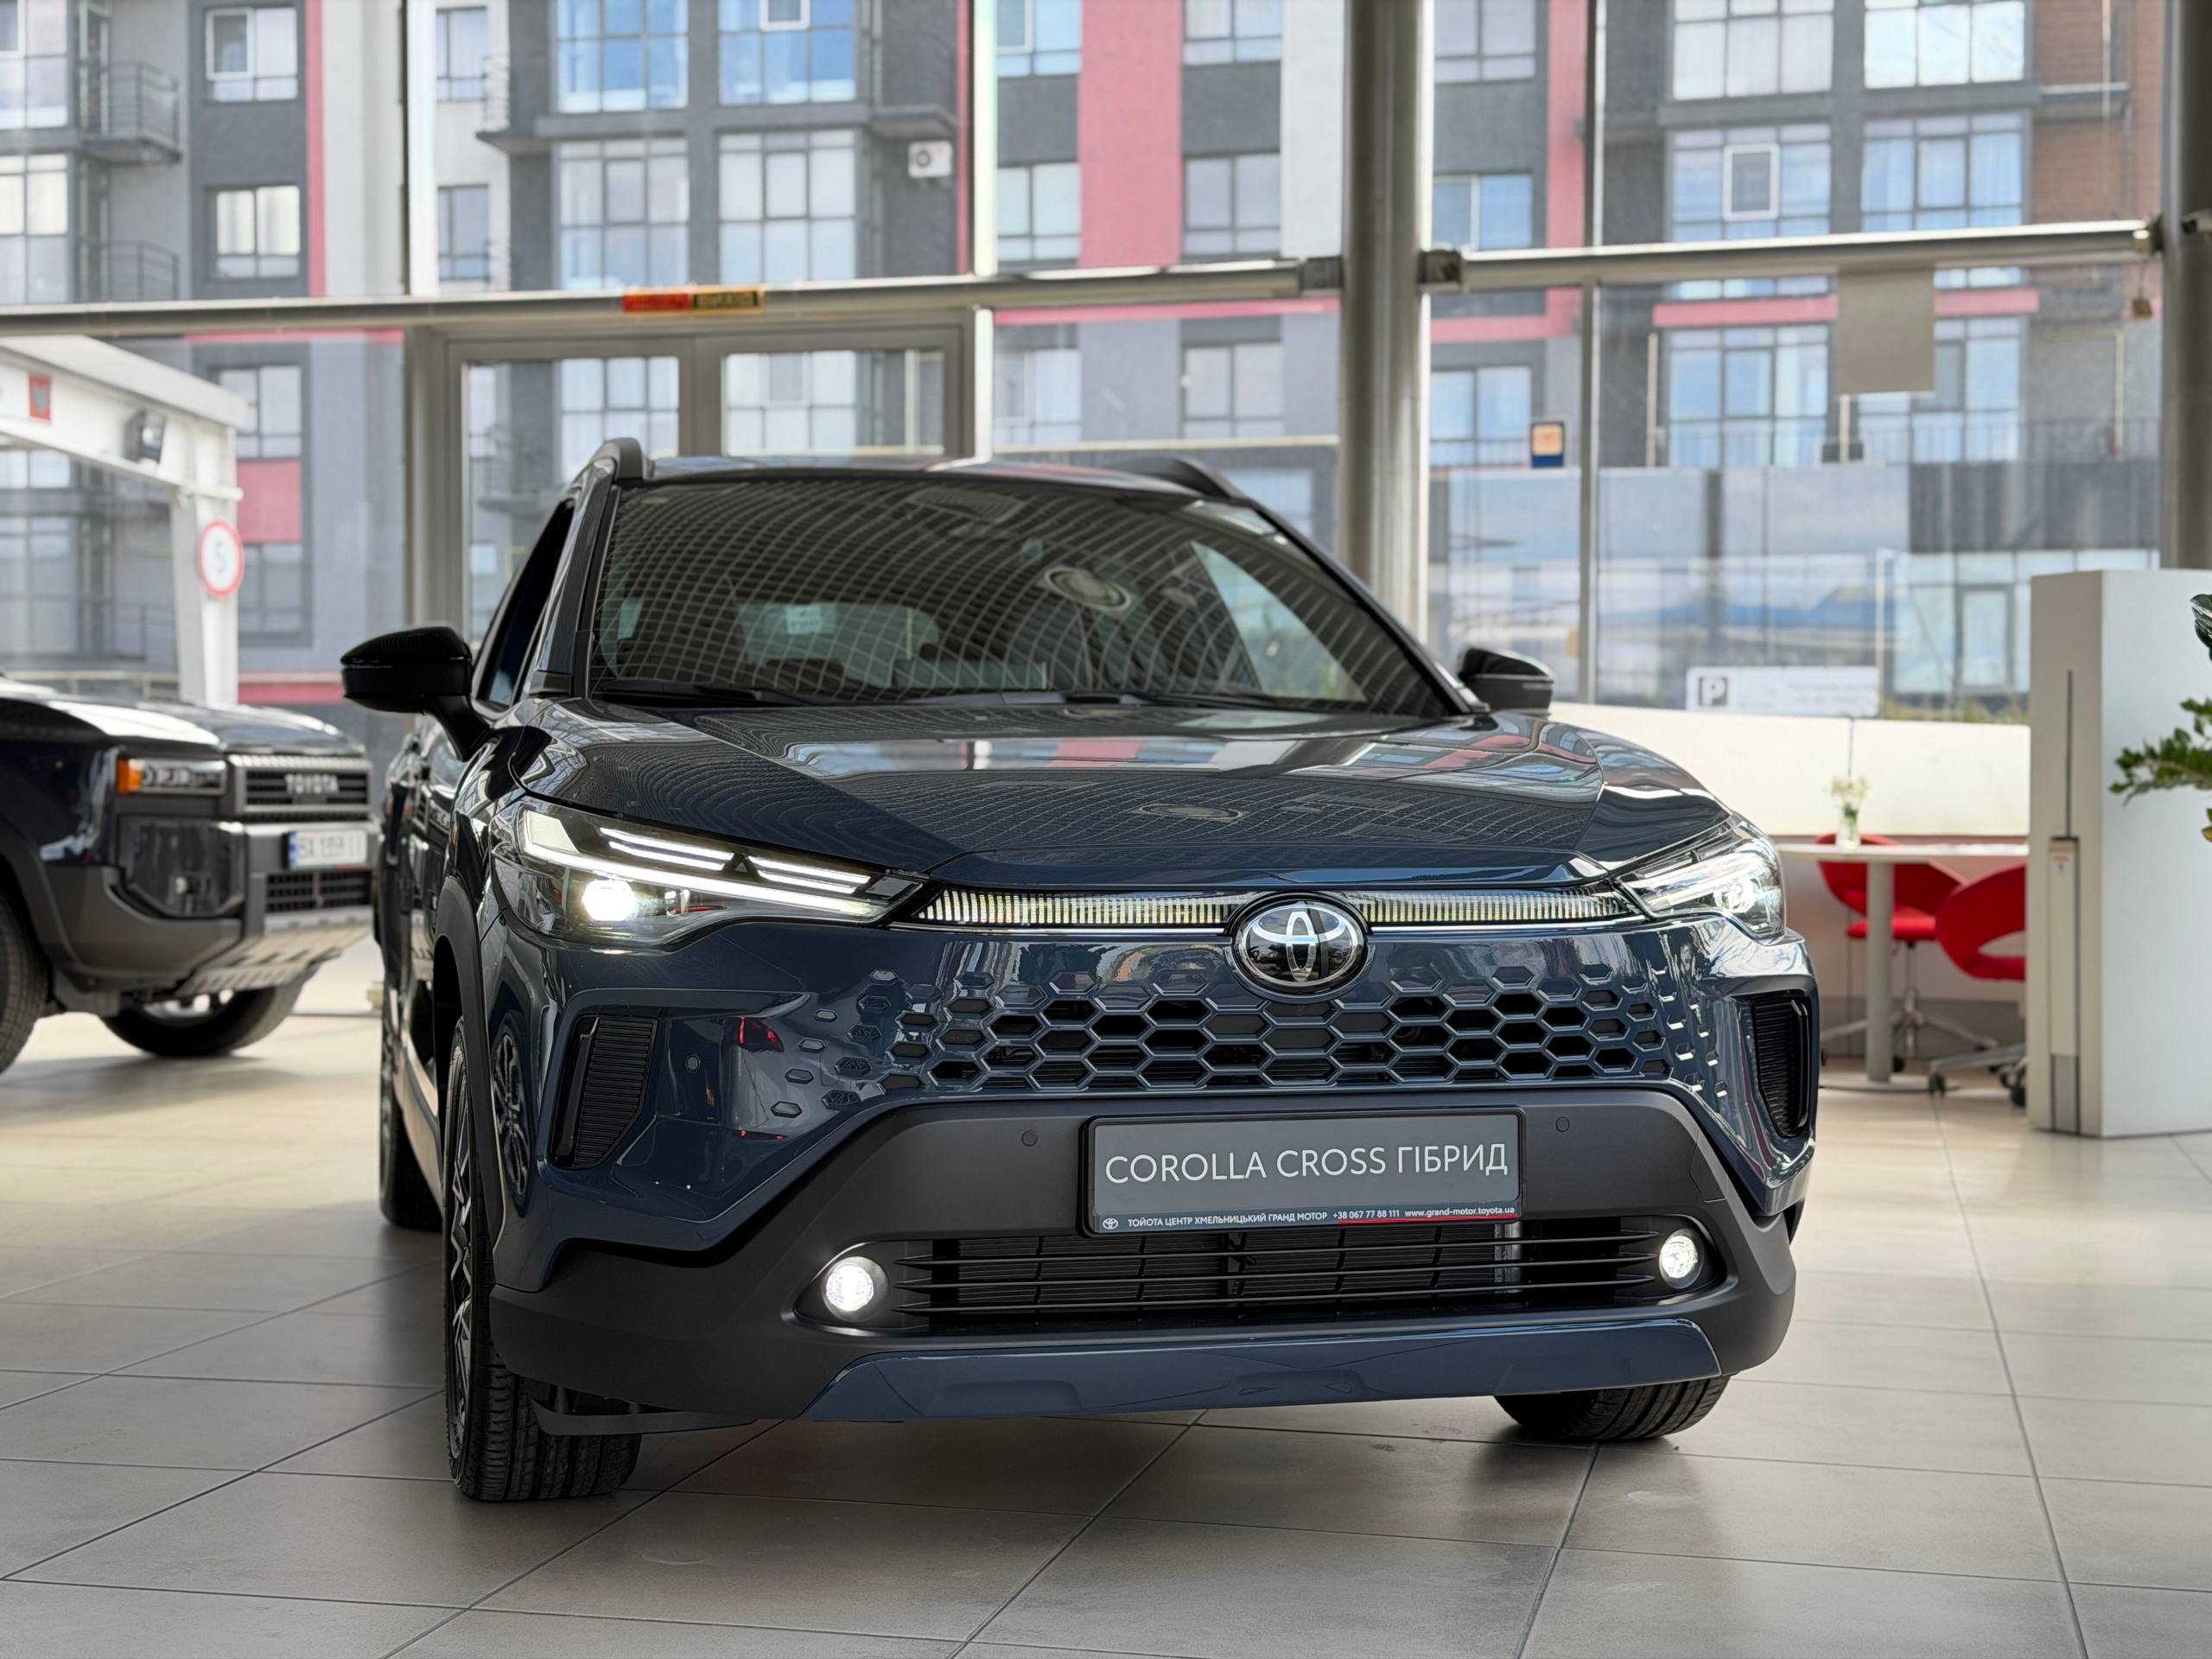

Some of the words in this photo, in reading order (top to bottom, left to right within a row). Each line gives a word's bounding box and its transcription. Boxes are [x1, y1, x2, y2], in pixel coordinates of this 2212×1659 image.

[1105, 1151, 1267, 1184] COROLLA
[1276, 1147, 1386, 1177] CROSS
[1397, 1143, 1508, 1176] ГІБРИД
[1128, 1217, 1163, 1227] ТОЙОТА
[1165, 1217, 1192, 1226] ЦЕНТР
[1194, 1212, 1267, 1224] ХМЕЛЬНИЦЬКИЙ
[1268, 1212, 1296, 1223] ГРАНД
[1297, 1211, 1327, 1221] МОТОР
[1333, 1211, 1347, 1219] +38
[1349, 1210, 1364, 1218] 067
[1365, 1209, 1376, 1217] 77
[1389, 1208, 1400, 1217] 111
[1405, 1206, 1515, 1217] www.grand-motor.toyota.ua
